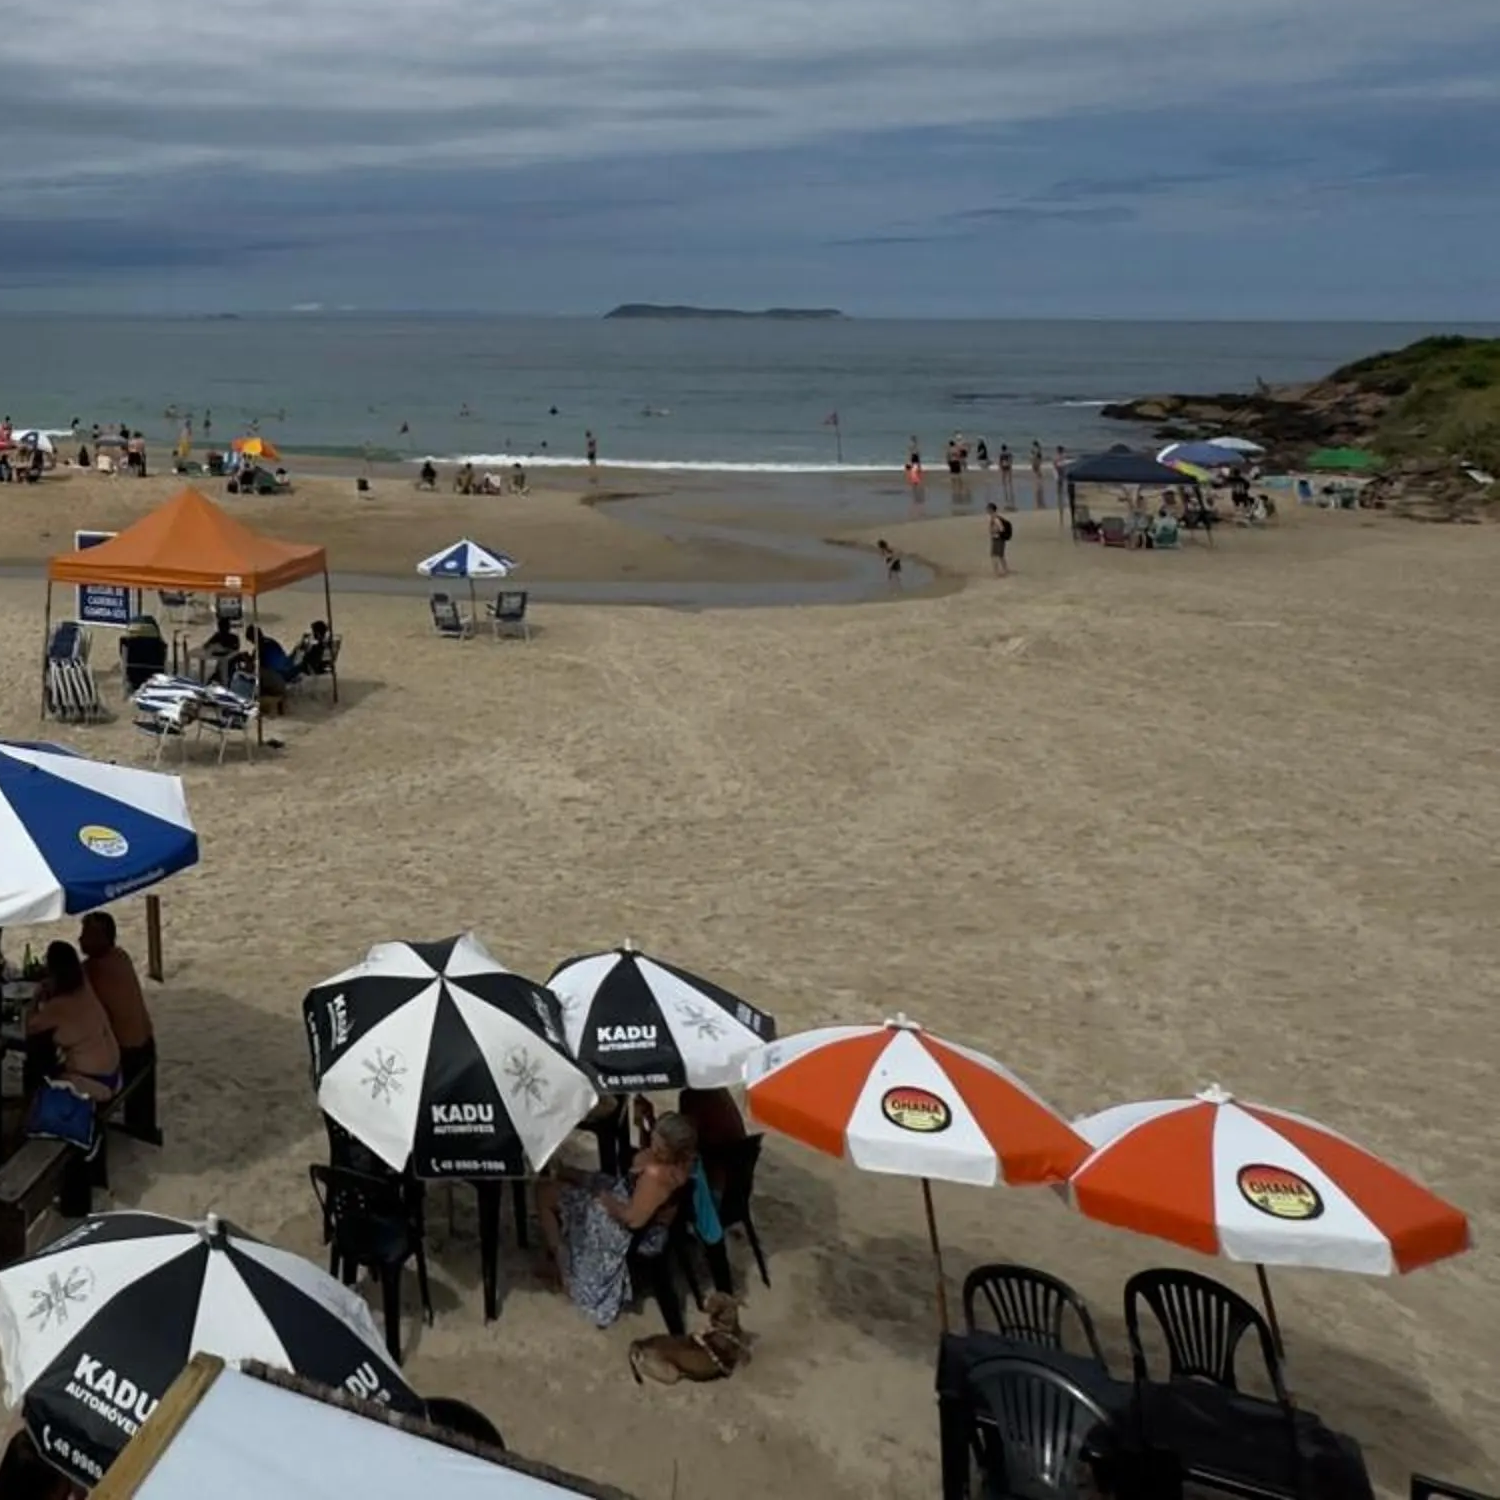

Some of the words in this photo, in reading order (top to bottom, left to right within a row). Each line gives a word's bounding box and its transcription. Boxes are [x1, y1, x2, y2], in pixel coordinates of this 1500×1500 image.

[597, 1025, 657, 1042] KADU
[431, 1103, 494, 1123] KADU
[73, 1353, 159, 1423] KADU
[65, 1381, 137, 1437] AUTOMÓVEI
